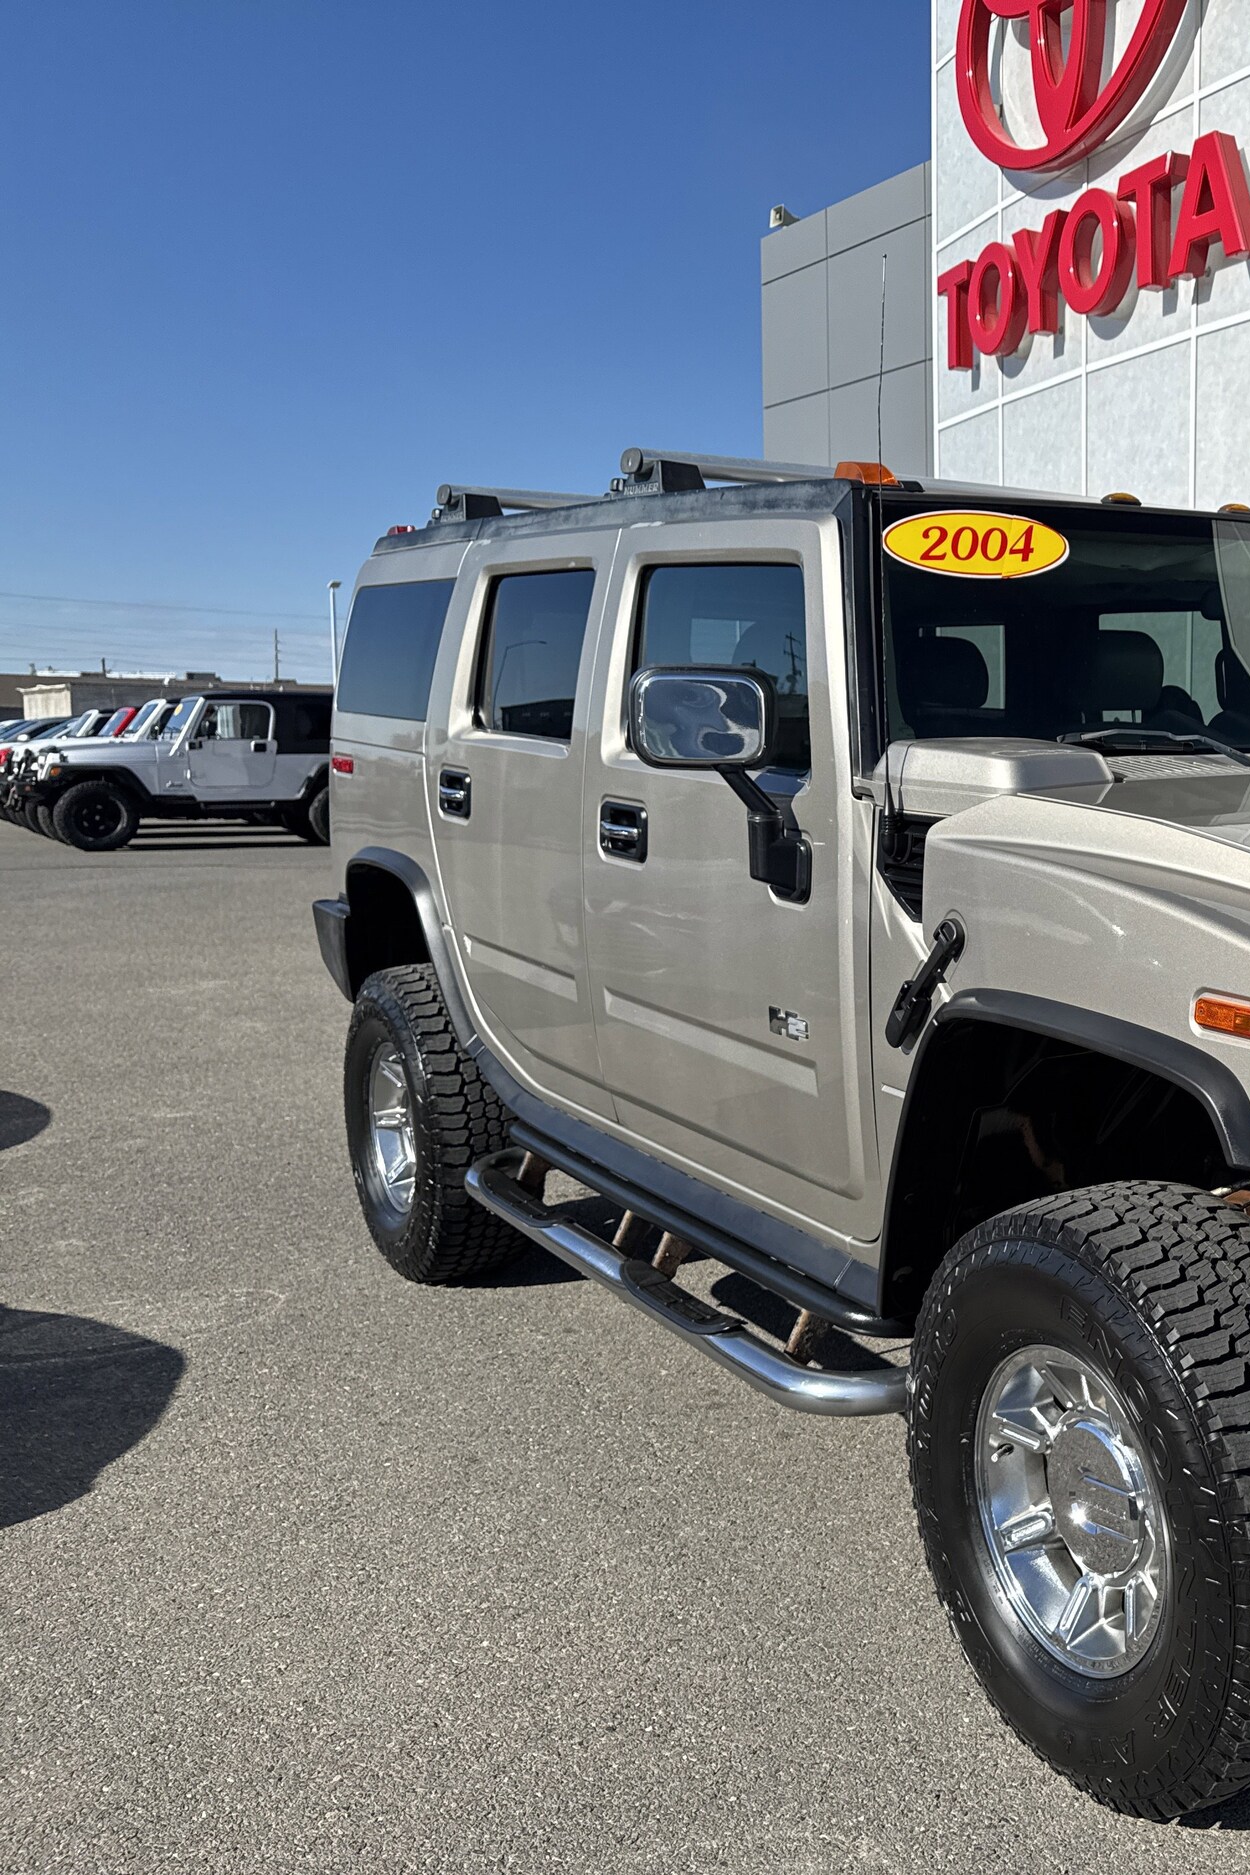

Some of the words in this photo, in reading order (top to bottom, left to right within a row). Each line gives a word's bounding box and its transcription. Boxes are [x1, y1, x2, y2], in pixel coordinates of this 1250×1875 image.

[919, 524, 1035, 563] 2004
[768, 1005, 809, 1041] H2
[1059, 1294, 1198, 1740] ENCOUNTER
